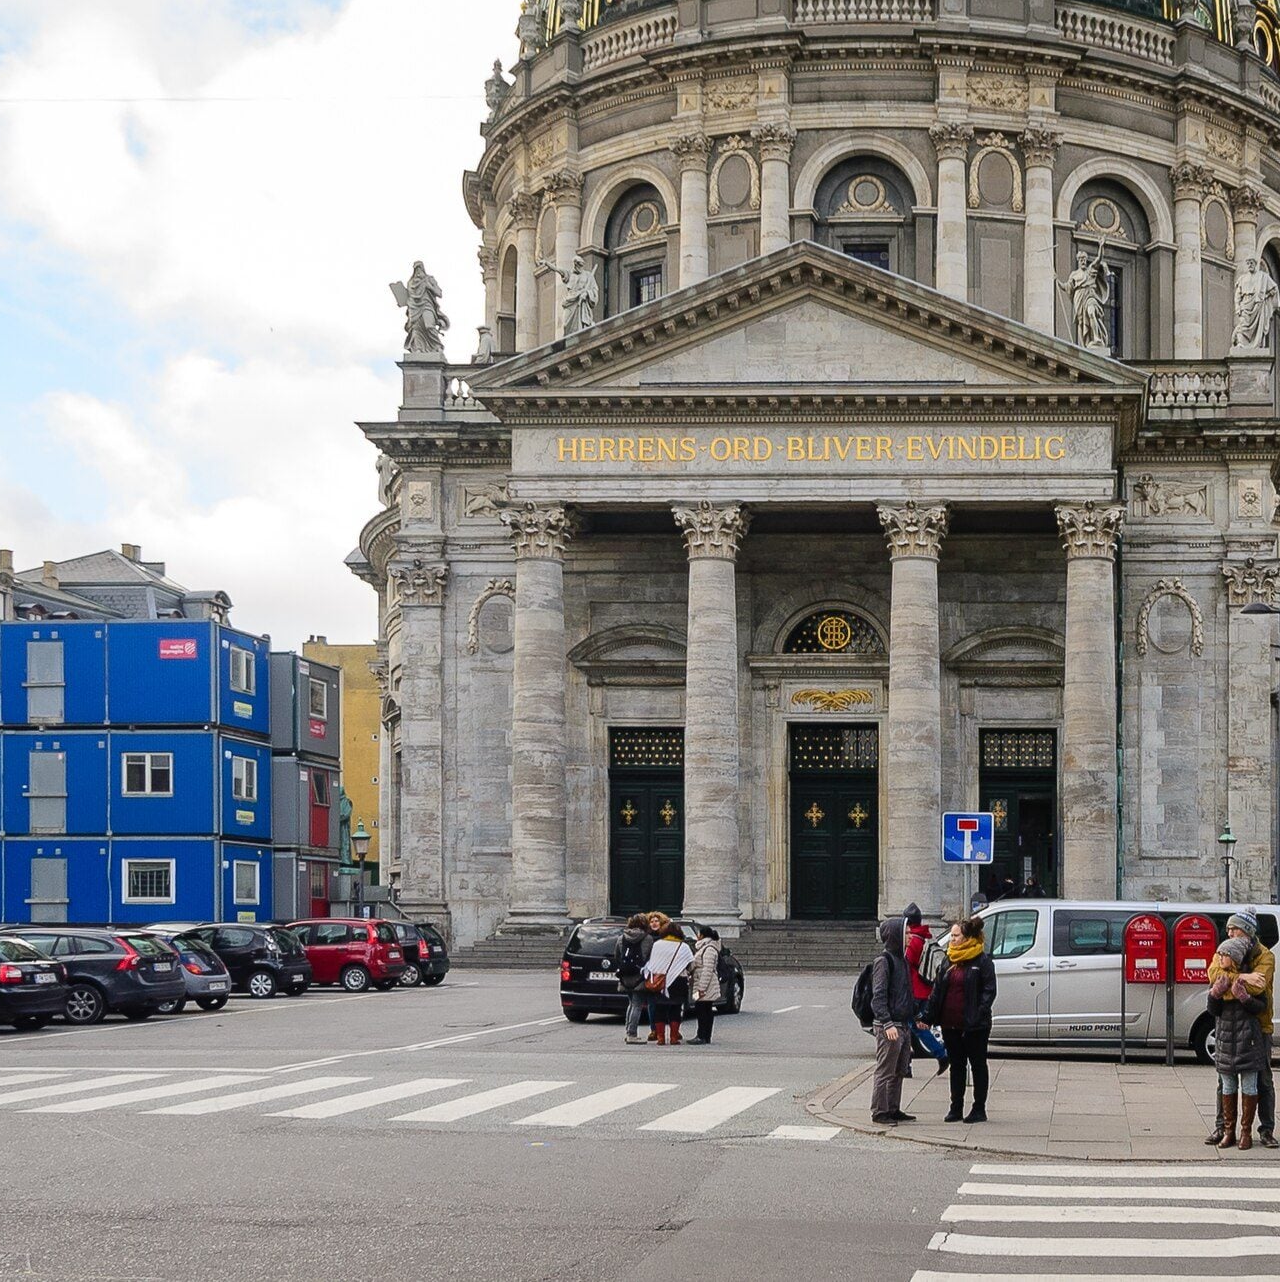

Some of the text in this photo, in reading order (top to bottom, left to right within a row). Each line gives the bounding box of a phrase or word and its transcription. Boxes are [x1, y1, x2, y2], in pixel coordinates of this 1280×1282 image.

[557, 435, 1066, 462] HERRENS ORD BLIVER EVINDELIG
[1069, 1024, 1093, 1032] HUGO
